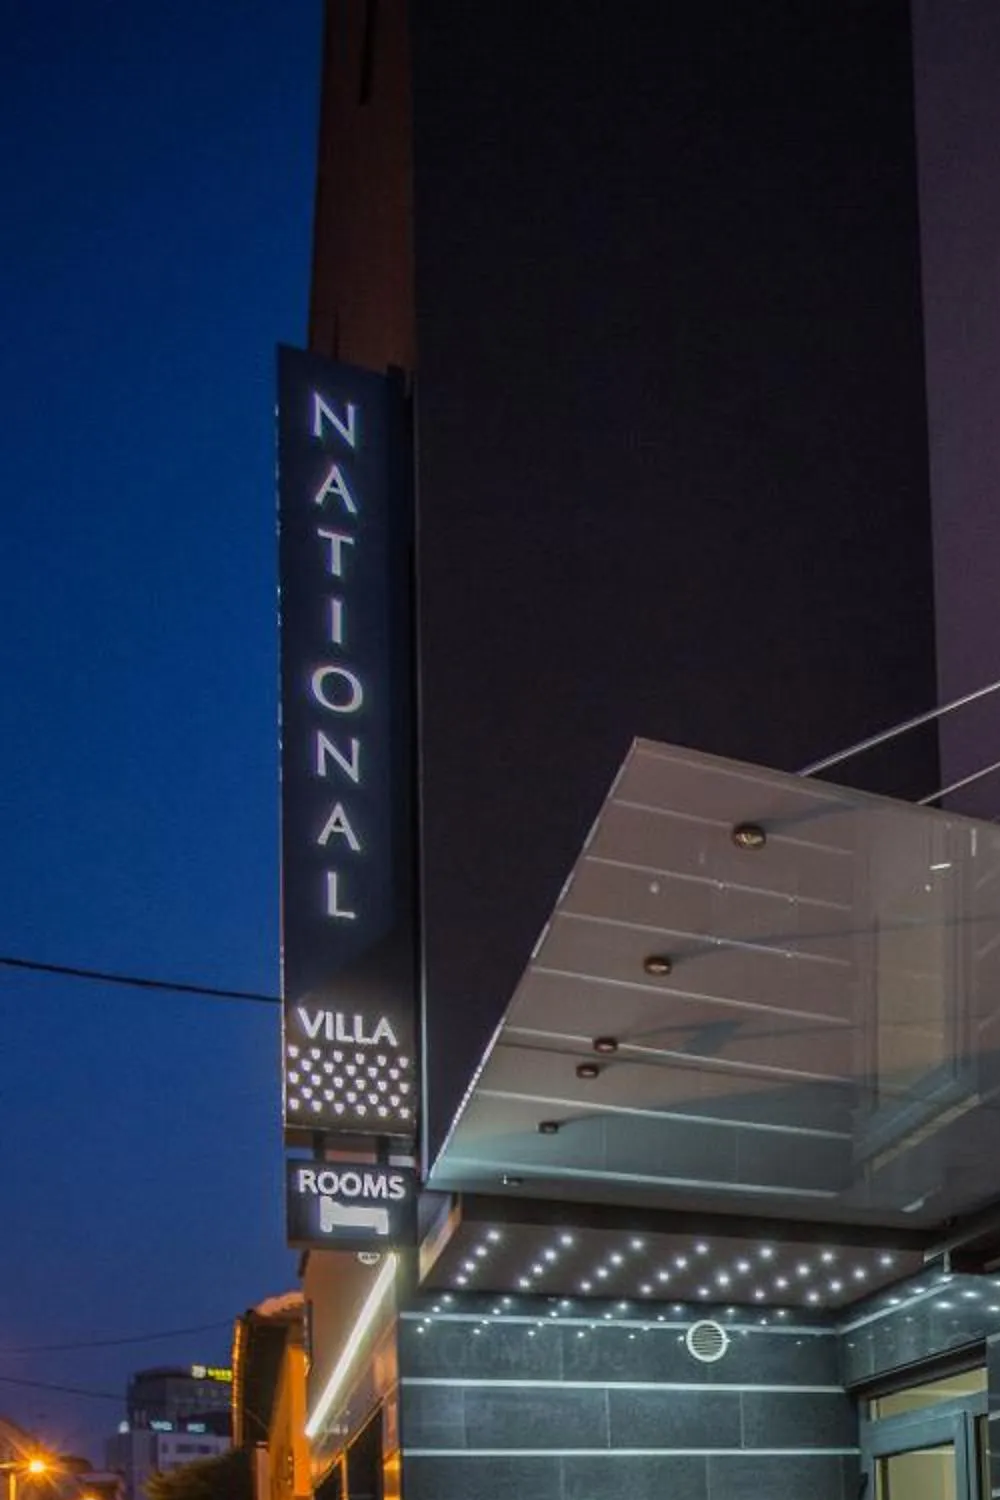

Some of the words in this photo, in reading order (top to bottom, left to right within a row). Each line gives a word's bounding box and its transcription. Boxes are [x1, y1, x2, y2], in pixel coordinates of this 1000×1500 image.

[311, 393, 363, 918] NATIONAL
[298, 1007, 398, 1047] VILLA
[299, 1168, 406, 1200] ROOMS
